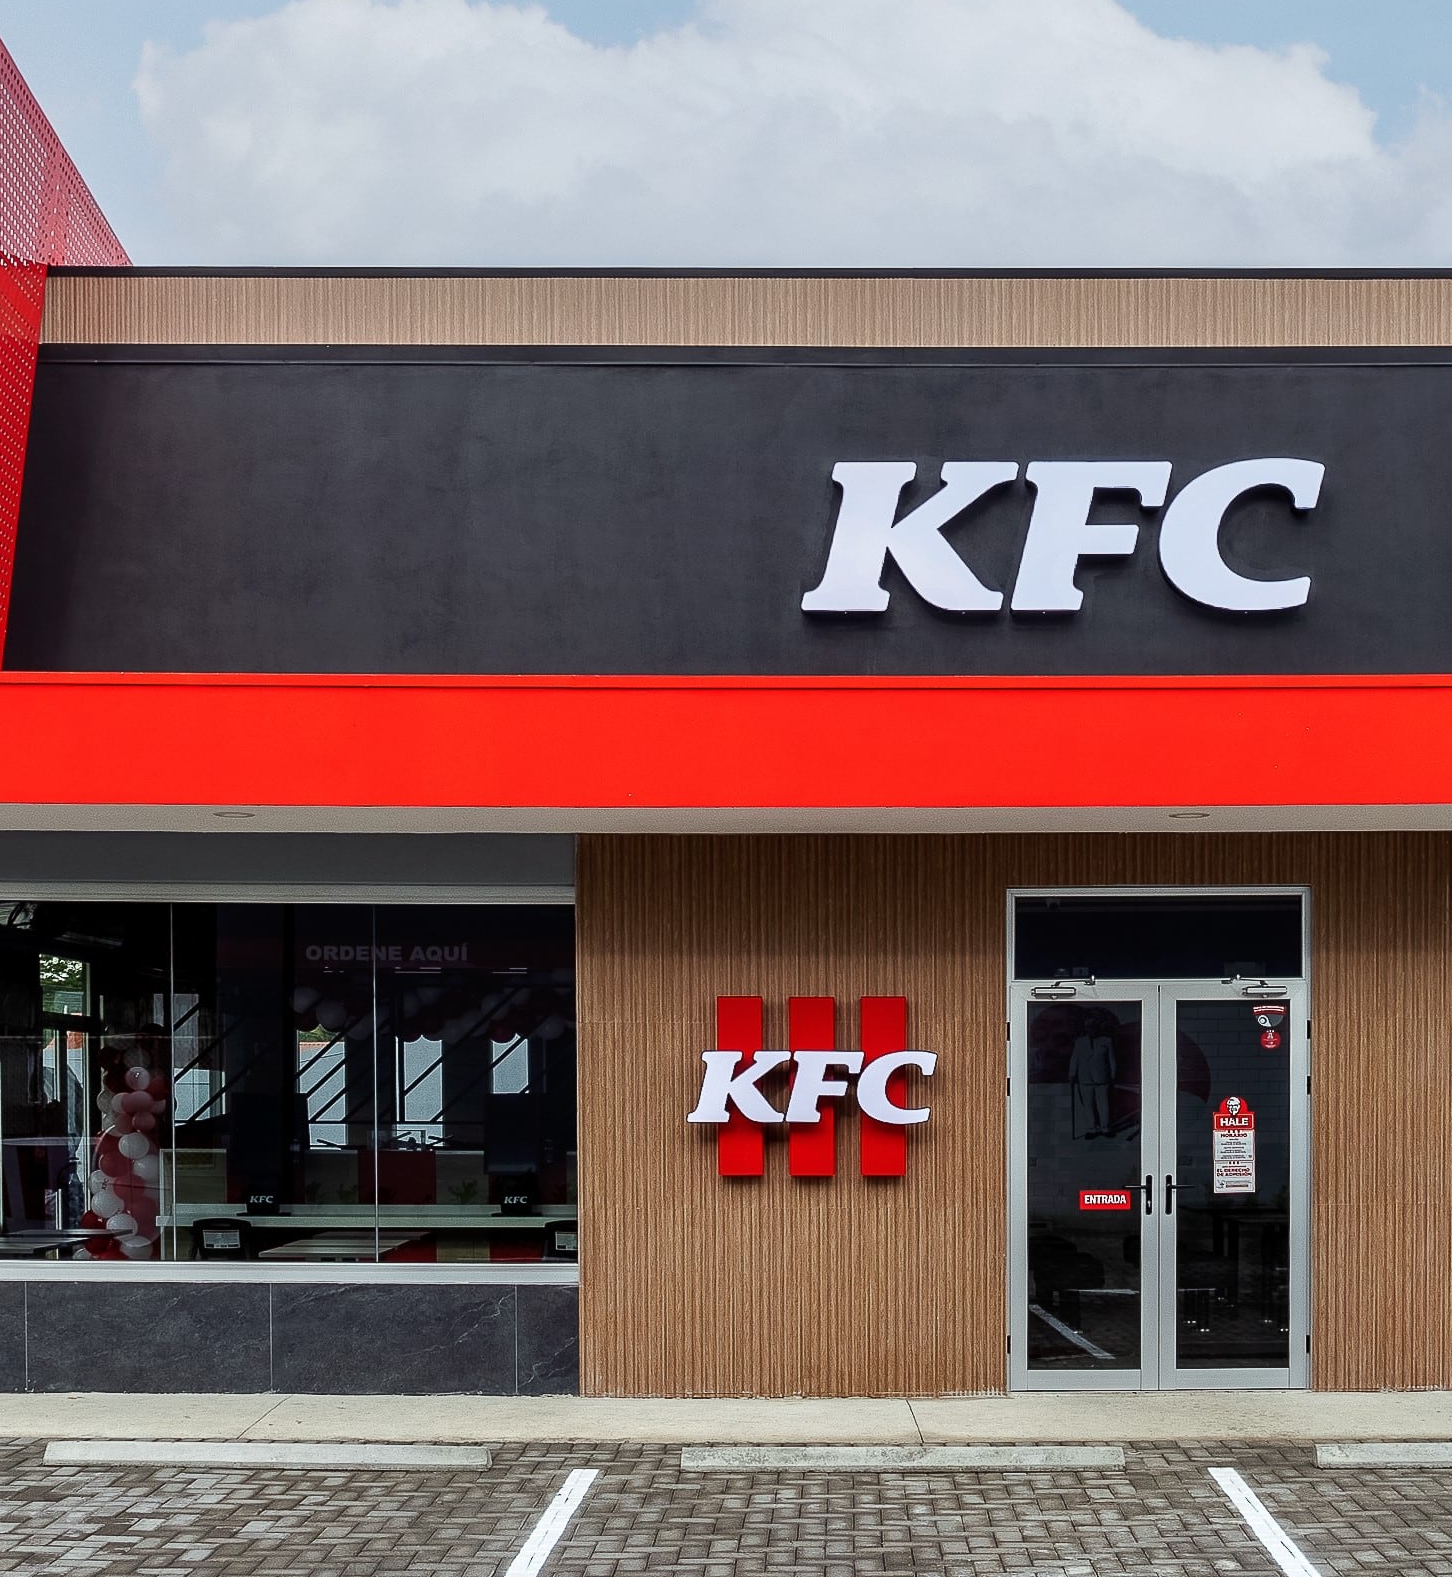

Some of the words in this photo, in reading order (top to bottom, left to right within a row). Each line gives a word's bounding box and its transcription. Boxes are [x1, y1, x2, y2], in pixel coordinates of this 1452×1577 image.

[800, 457, 1326, 613] KFC
[305, 944, 403, 961] ORDENE
[409, 942, 468, 962] AQUÍ
[686, 1050, 938, 1124] KFC
[1220, 1117, 1249, 1127] HALE
[249, 1195, 274, 1203] KFC
[503, 1196, 528, 1204] KFC
[1084, 1194, 1127, 1204] ENTRADA
